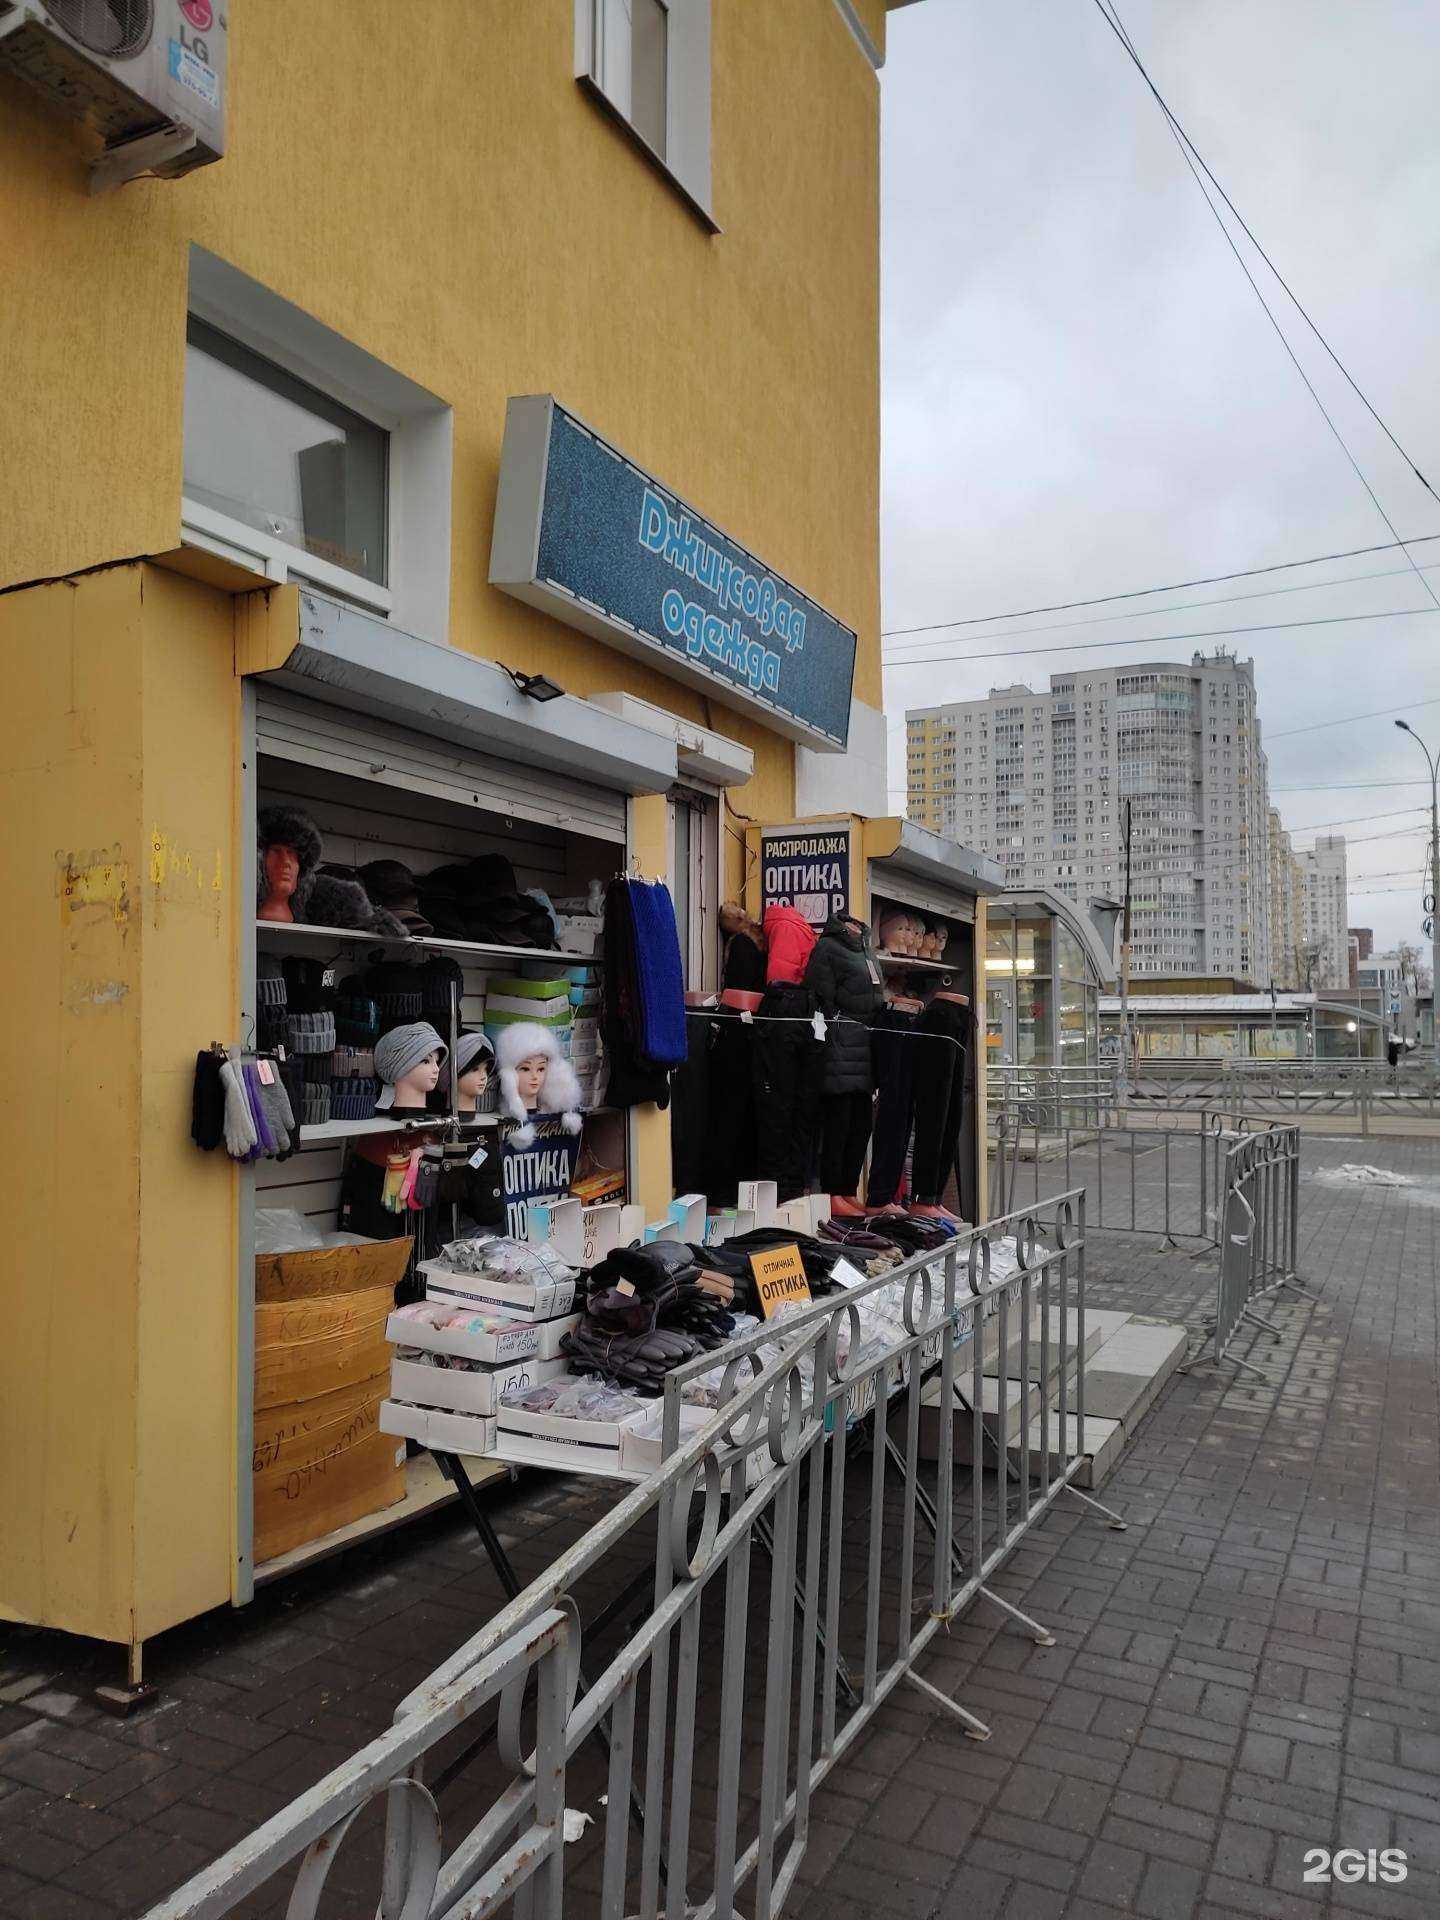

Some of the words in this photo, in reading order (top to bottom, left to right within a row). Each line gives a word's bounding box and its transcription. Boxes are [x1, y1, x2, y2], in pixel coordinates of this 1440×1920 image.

[180, 24, 208, 64] LG
[765, 837, 847, 858] РАСПРОДАЖА
[765, 862, 843, 893] ОПТИКА
[503, 1149, 570, 1196] ОПТИКА
[763, 1257, 795, 1274] ОТЛИЧНАЯ
[762, 1273, 807, 1300] ОПТИКА
